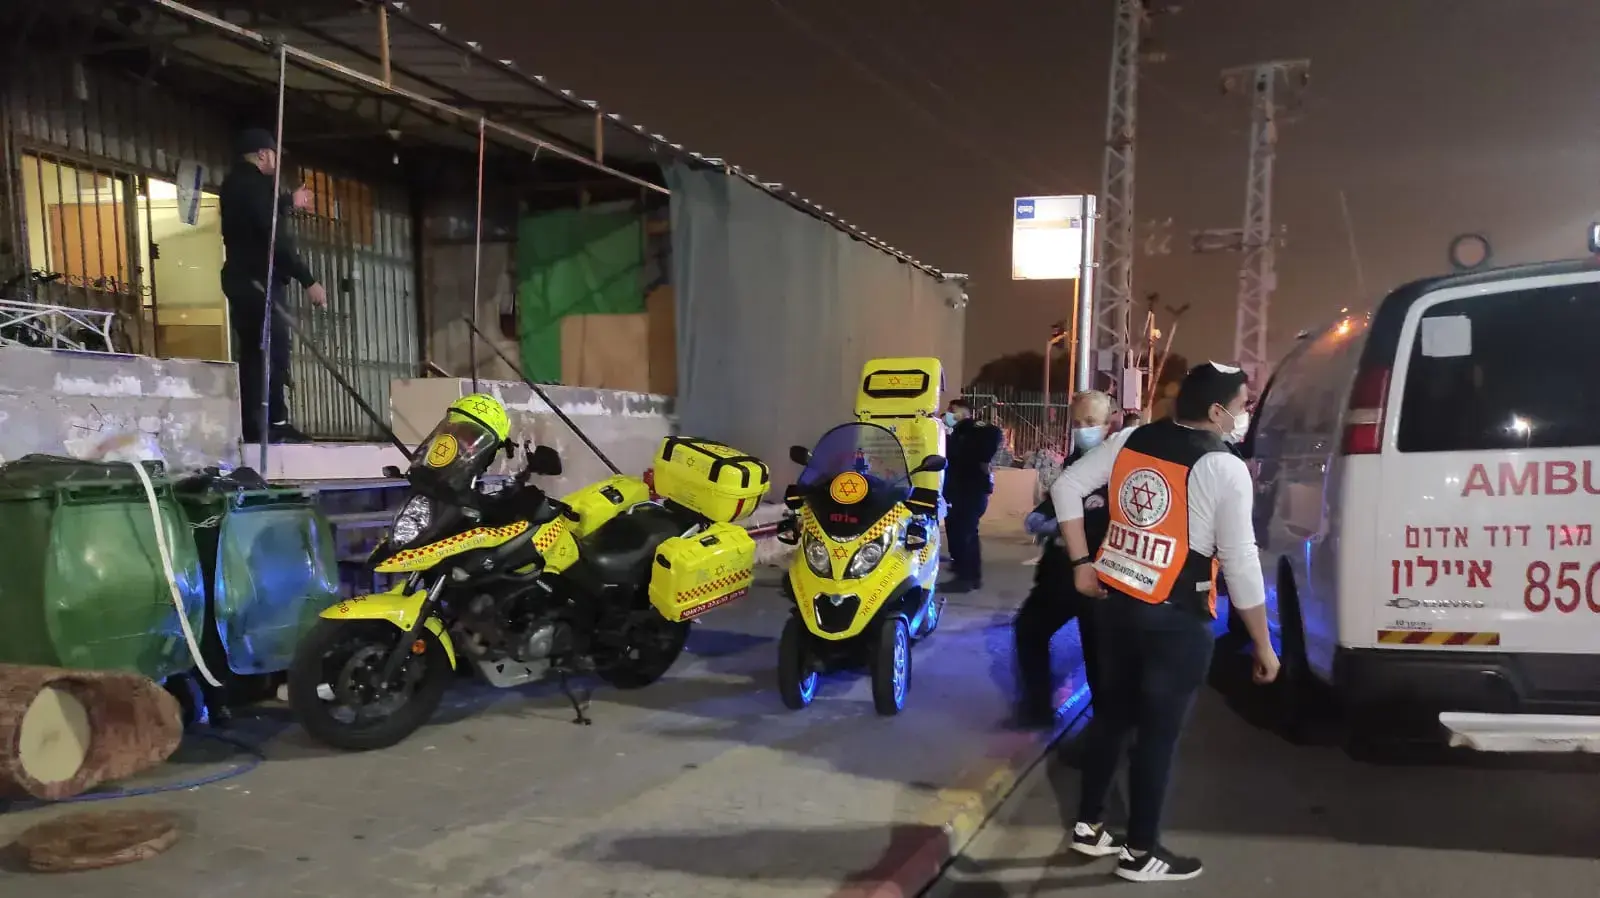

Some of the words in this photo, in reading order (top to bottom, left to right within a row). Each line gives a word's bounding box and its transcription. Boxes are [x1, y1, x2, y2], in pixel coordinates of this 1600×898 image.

[1461, 460, 1600, 497] AMBU
[1108, 524, 1172, 564] חובש
[1405, 525, 1469, 548] אדום
[1483, 525, 1531, 547] דוד
[1546, 524, 1592, 550] מגן
[1392, 555, 1493, 594] איילון
[1523, 560, 1600, 613] 850
